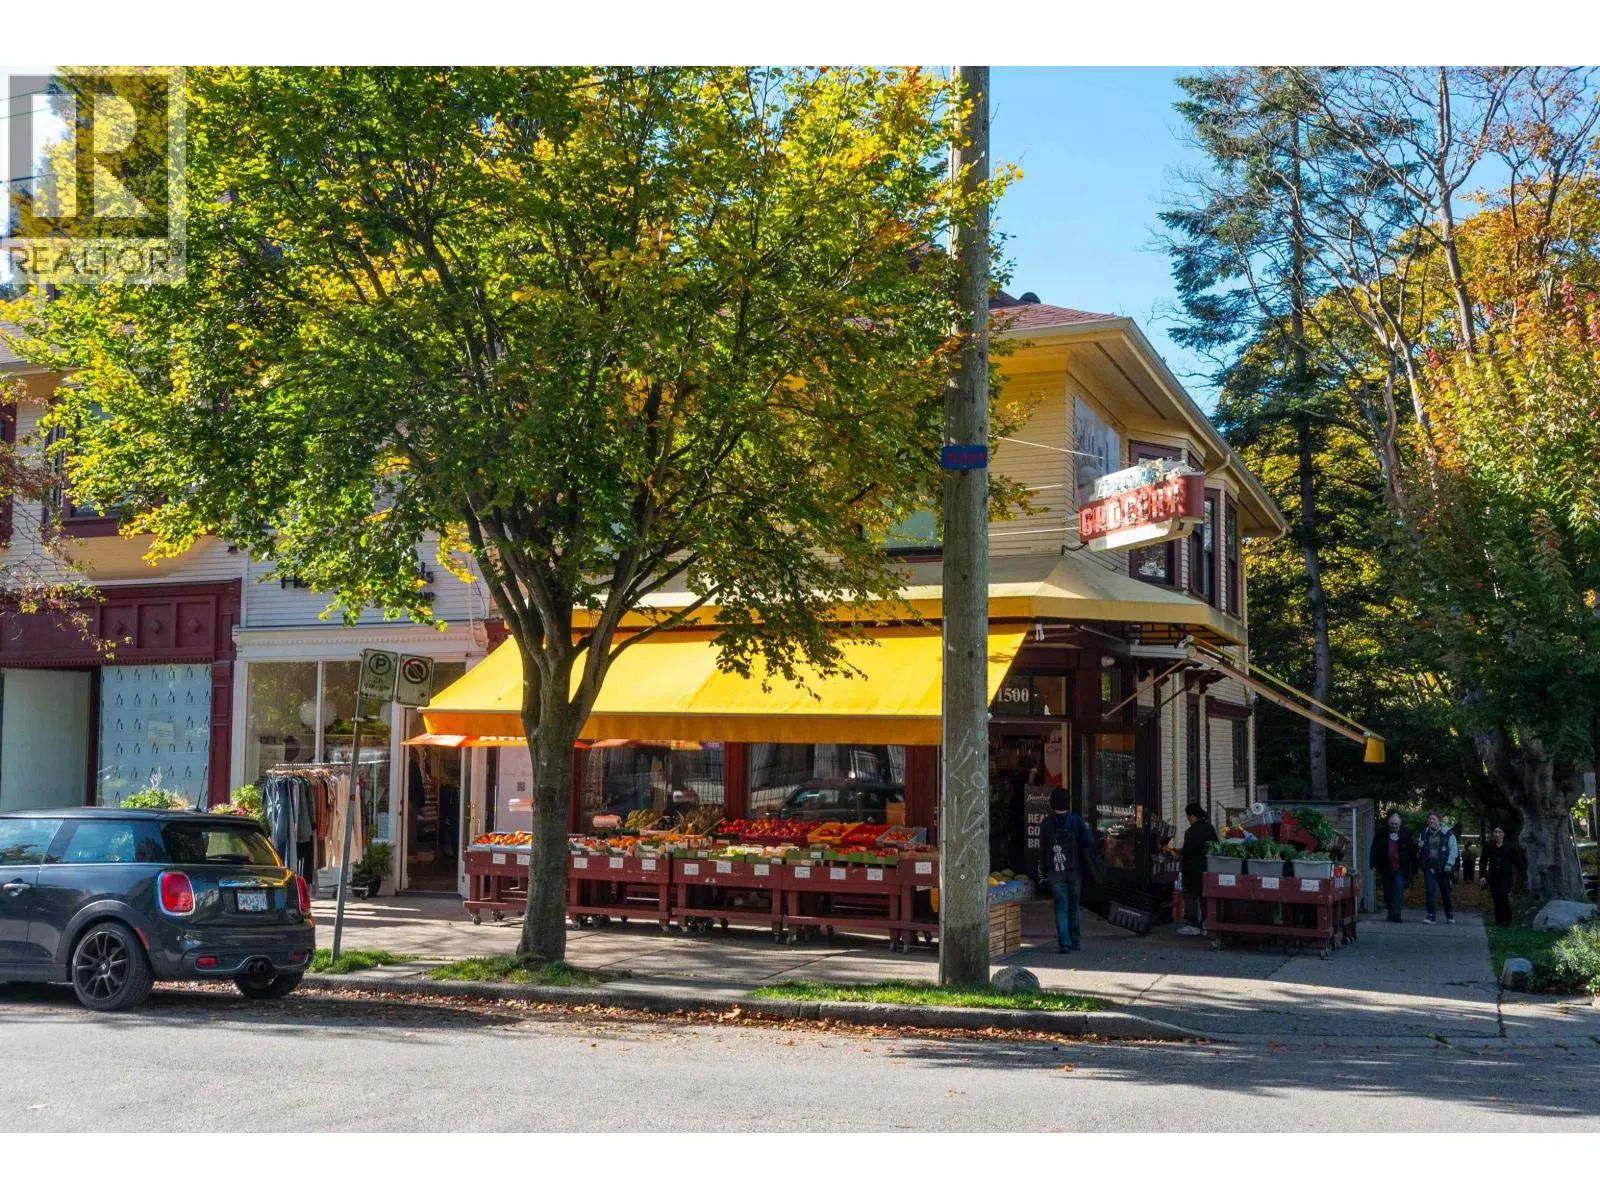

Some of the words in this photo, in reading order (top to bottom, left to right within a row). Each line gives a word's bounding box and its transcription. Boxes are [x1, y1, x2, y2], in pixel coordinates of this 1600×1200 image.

[1080, 484, 1181, 537] GROCERY
[997, 688, 1030, 702] 1500
[1027, 813, 1048, 823] REA
[1027, 826, 1041, 836] GO
[1027, 838, 1041, 849] BR
